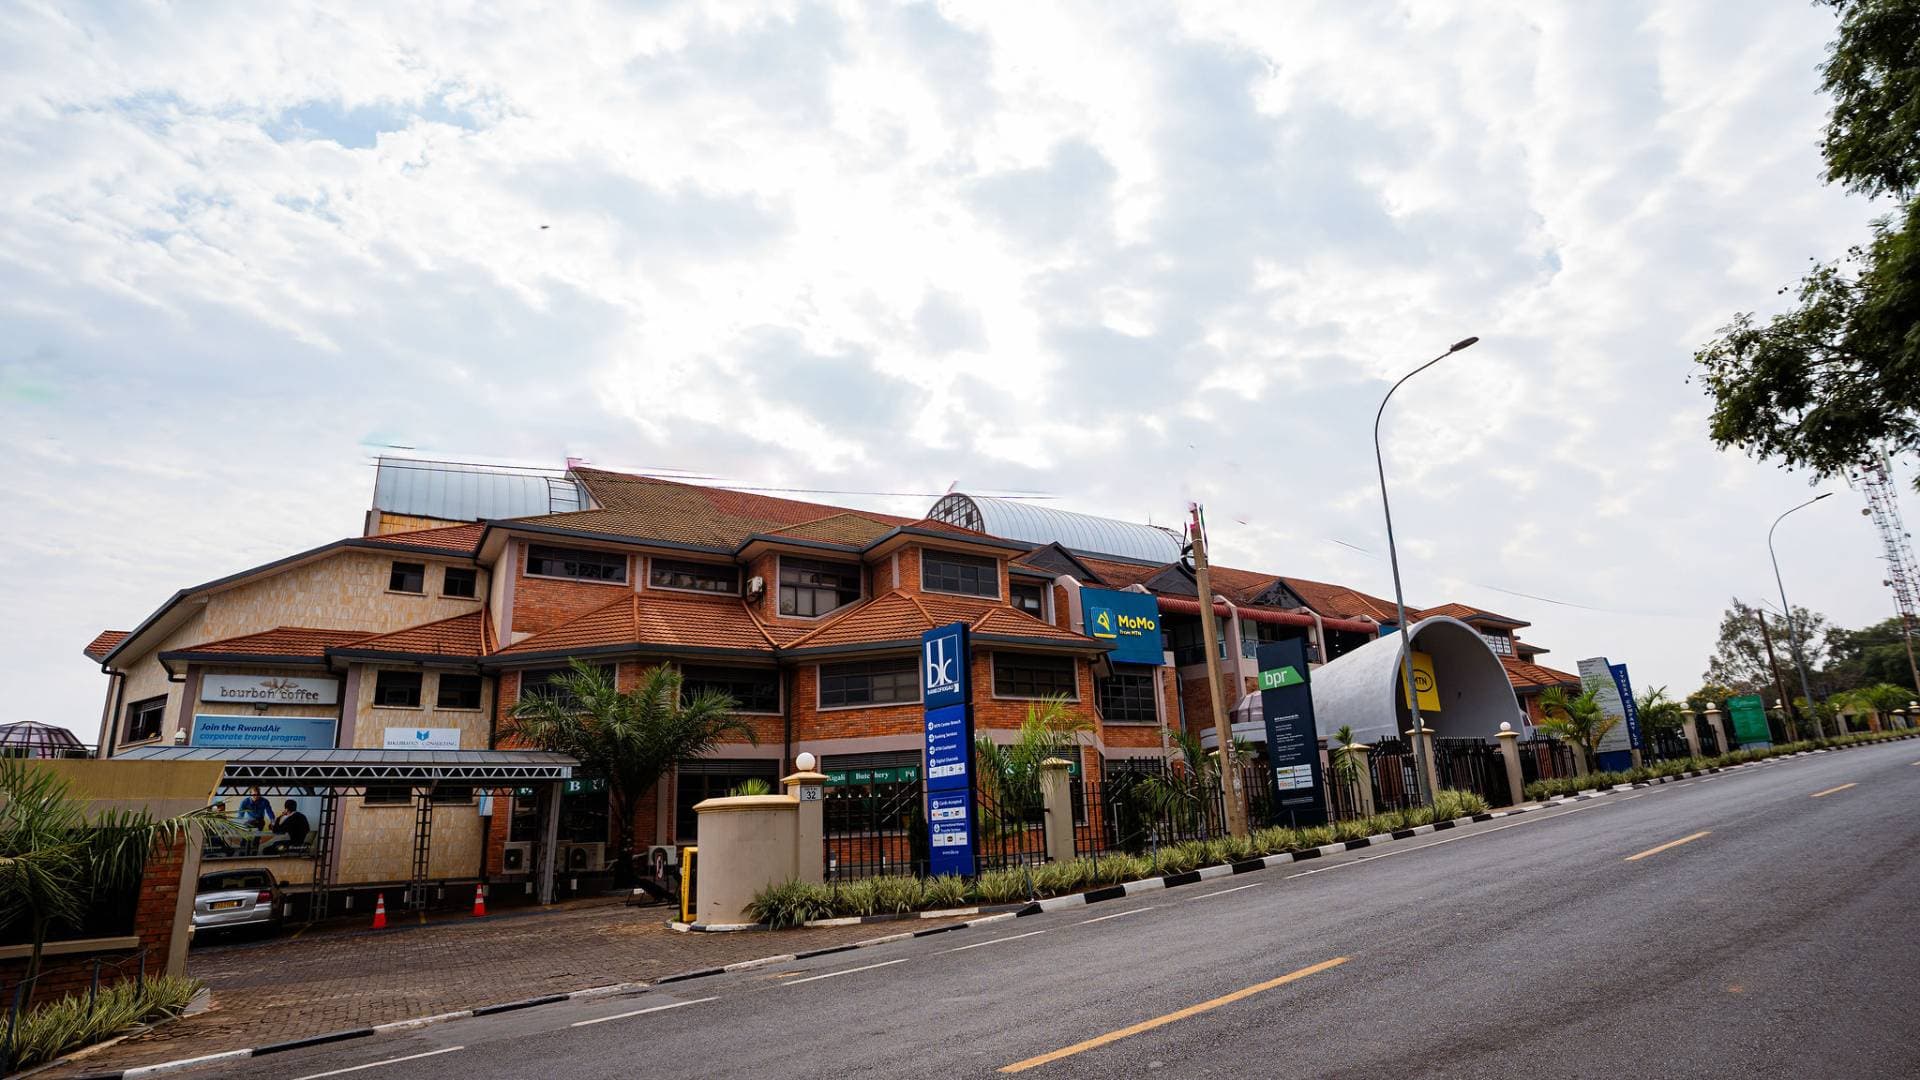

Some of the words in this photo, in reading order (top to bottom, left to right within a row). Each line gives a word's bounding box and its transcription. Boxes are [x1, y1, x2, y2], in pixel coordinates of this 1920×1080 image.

[1118, 614, 1155, 631] MoMo
[1264, 670, 1288, 688] bpr
[220, 686, 277, 699] bourbon
[279, 688, 319, 701] coffee
[200, 723, 219, 732] Join
[221, 723, 235, 731] the
[237, 724, 281, 733] RwandAir
[200, 733, 244, 742] corporate
[245, 733, 270, 741] travel
[271, 734, 307, 743] program
[855, 771, 889, 780] Butchery
[806, 790, 816, 800] 32
